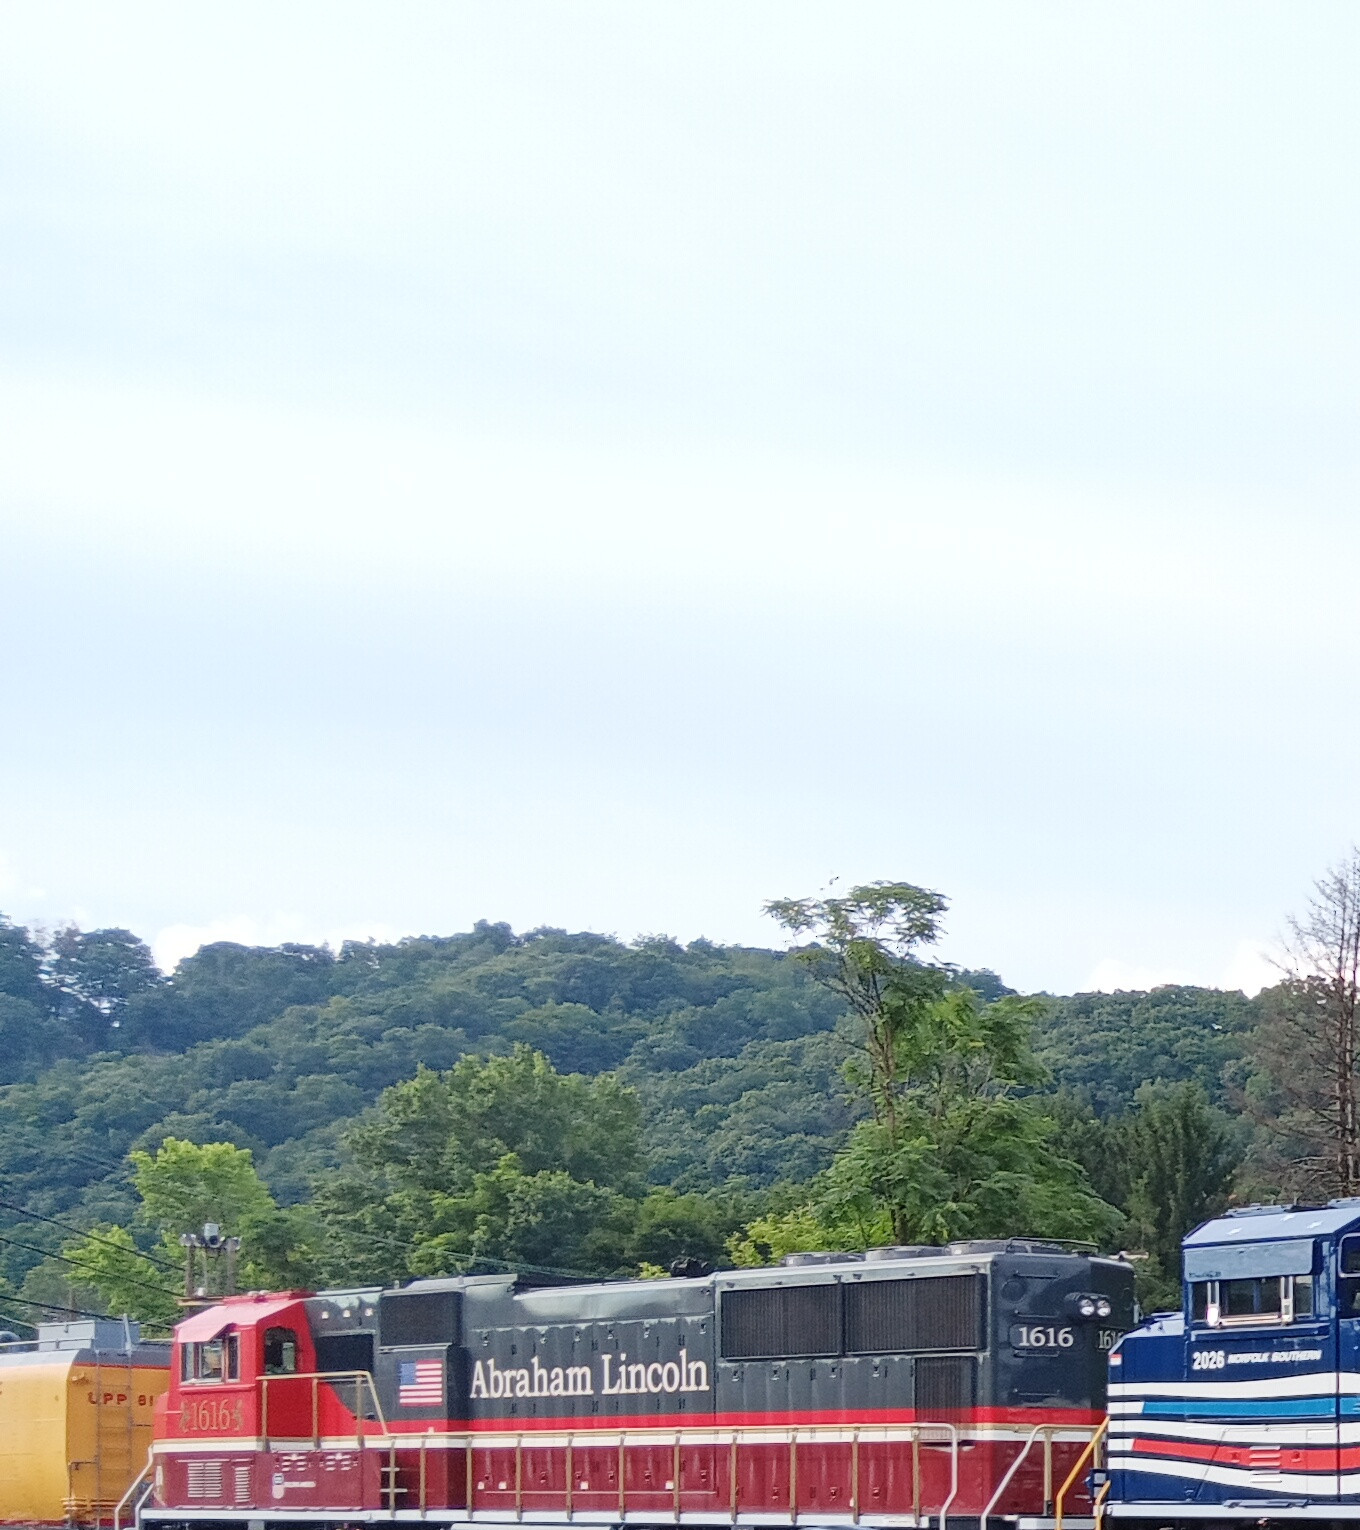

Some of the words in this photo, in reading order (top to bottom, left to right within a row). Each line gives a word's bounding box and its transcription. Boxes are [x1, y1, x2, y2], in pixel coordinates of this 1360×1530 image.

[1018, 1326, 1074, 1348] 1616
[470, 1355, 594, 1399] Abraham
[601, 1348, 710, 1395] Lincoln
[1192, 1350, 1225, 1370] 2026
[1228, 1352, 1270, 1364] NORFOLK
[1271, 1350, 1322, 1362] SOUTHERN
[191, 1398, 231, 1431] 1616
